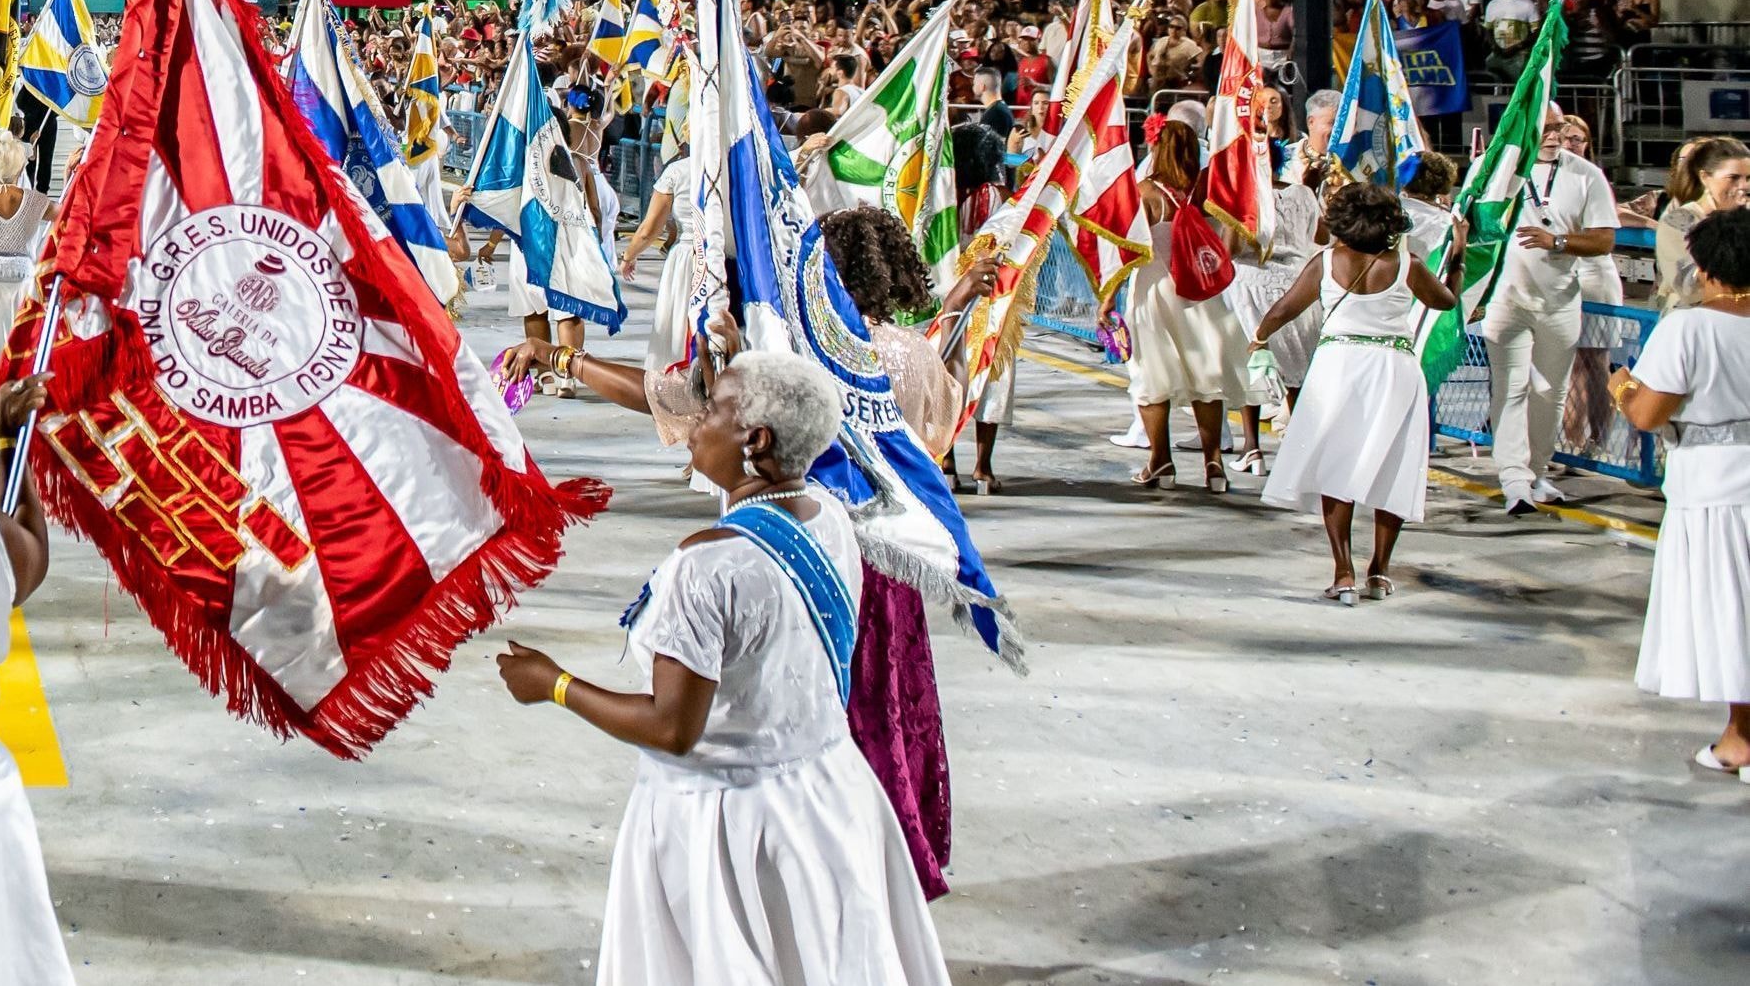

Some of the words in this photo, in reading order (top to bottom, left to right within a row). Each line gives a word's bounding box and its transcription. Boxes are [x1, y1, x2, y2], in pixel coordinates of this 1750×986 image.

[151, 214, 233, 282] G.R.E.S.
[240, 212, 332, 275] UNIDOS
[212, 292, 259, 334] GALERIA
[260, 329, 279, 348] DA
[322, 280, 350, 317] DE
[139, 299, 165, 349] DNA
[155, 353, 189, 389] DO
[191, 387, 282, 420] SAMBA
[296, 320, 356, 396] BANGU
